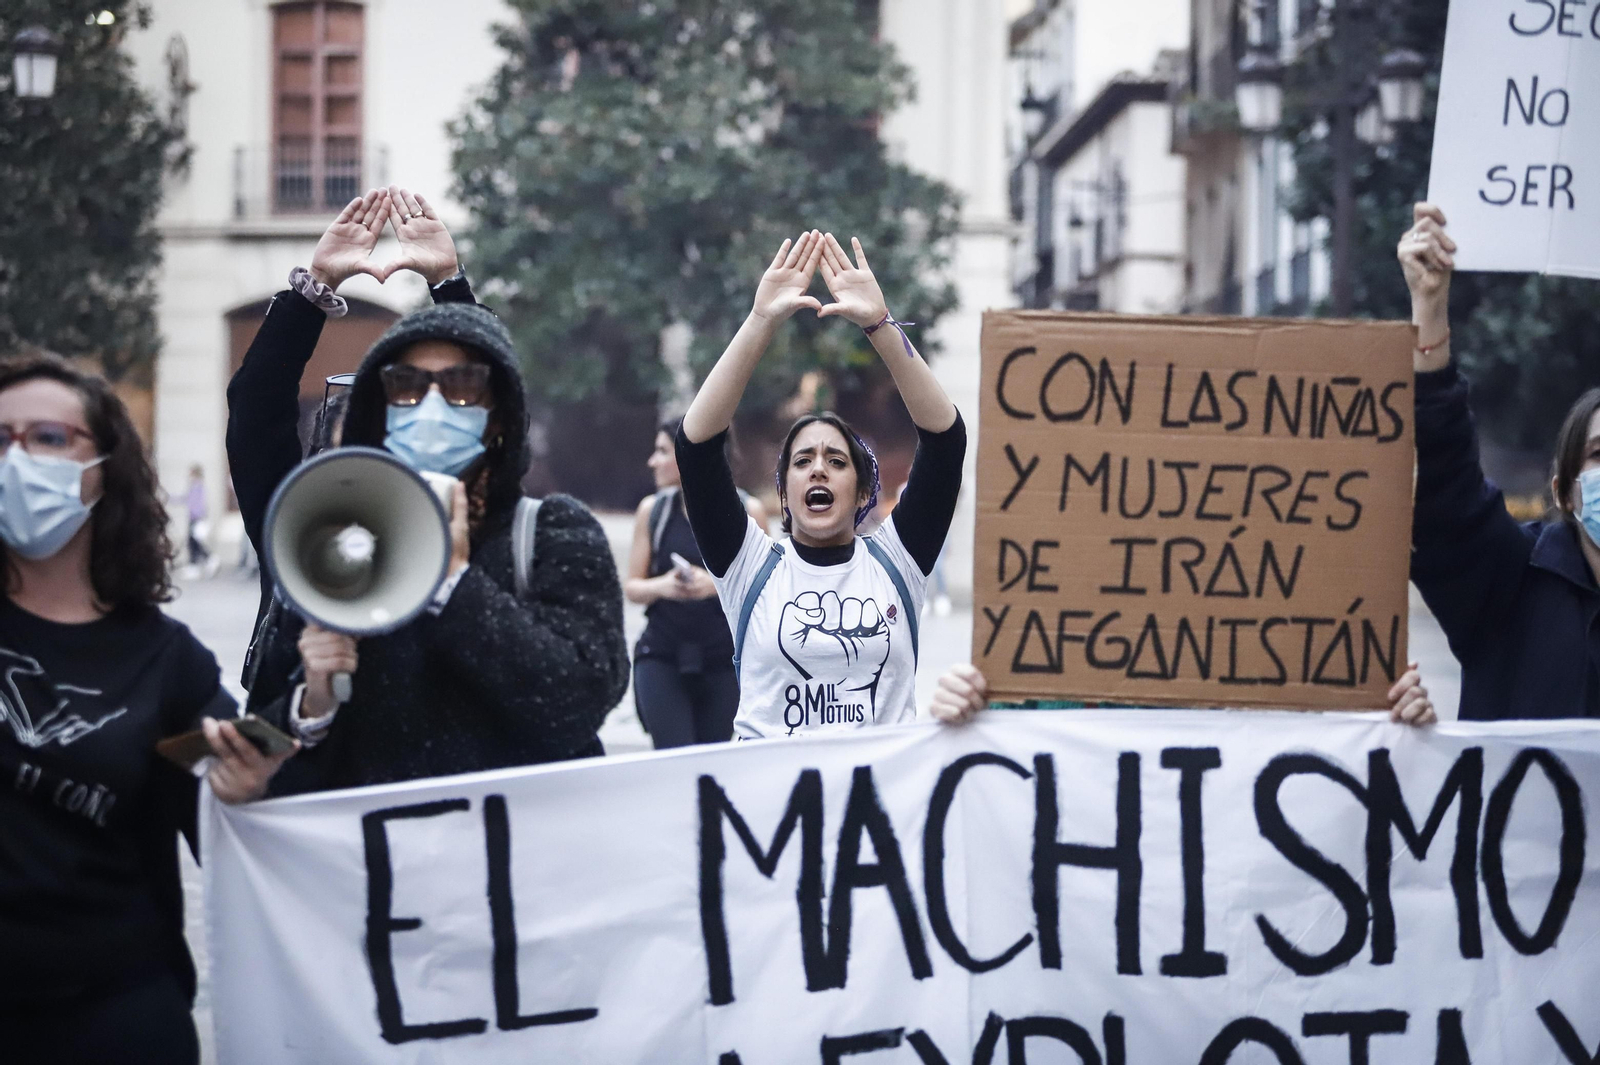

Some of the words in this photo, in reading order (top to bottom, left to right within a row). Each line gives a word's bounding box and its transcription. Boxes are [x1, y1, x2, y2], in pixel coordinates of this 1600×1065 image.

[1508, 0, 1600, 38] SE
[1478, 164, 1575, 210] SER
[996, 346, 1136, 425] CON
[1161, 363, 1258, 431] LAS
[1263, 374, 1408, 444] NIÑAS
[1000, 443, 1040, 512] Y
[1059, 451, 1369, 531] MUJERES
[999, 537, 1060, 593] DE
[1100, 525, 1304, 600] IRÁN
[982, 604, 1010, 657] Y
[1011, 598, 1400, 687] AFGANISTÁN
[361, 793, 599, 1045] EL
[696, 746, 1587, 1007] MACHISMO
